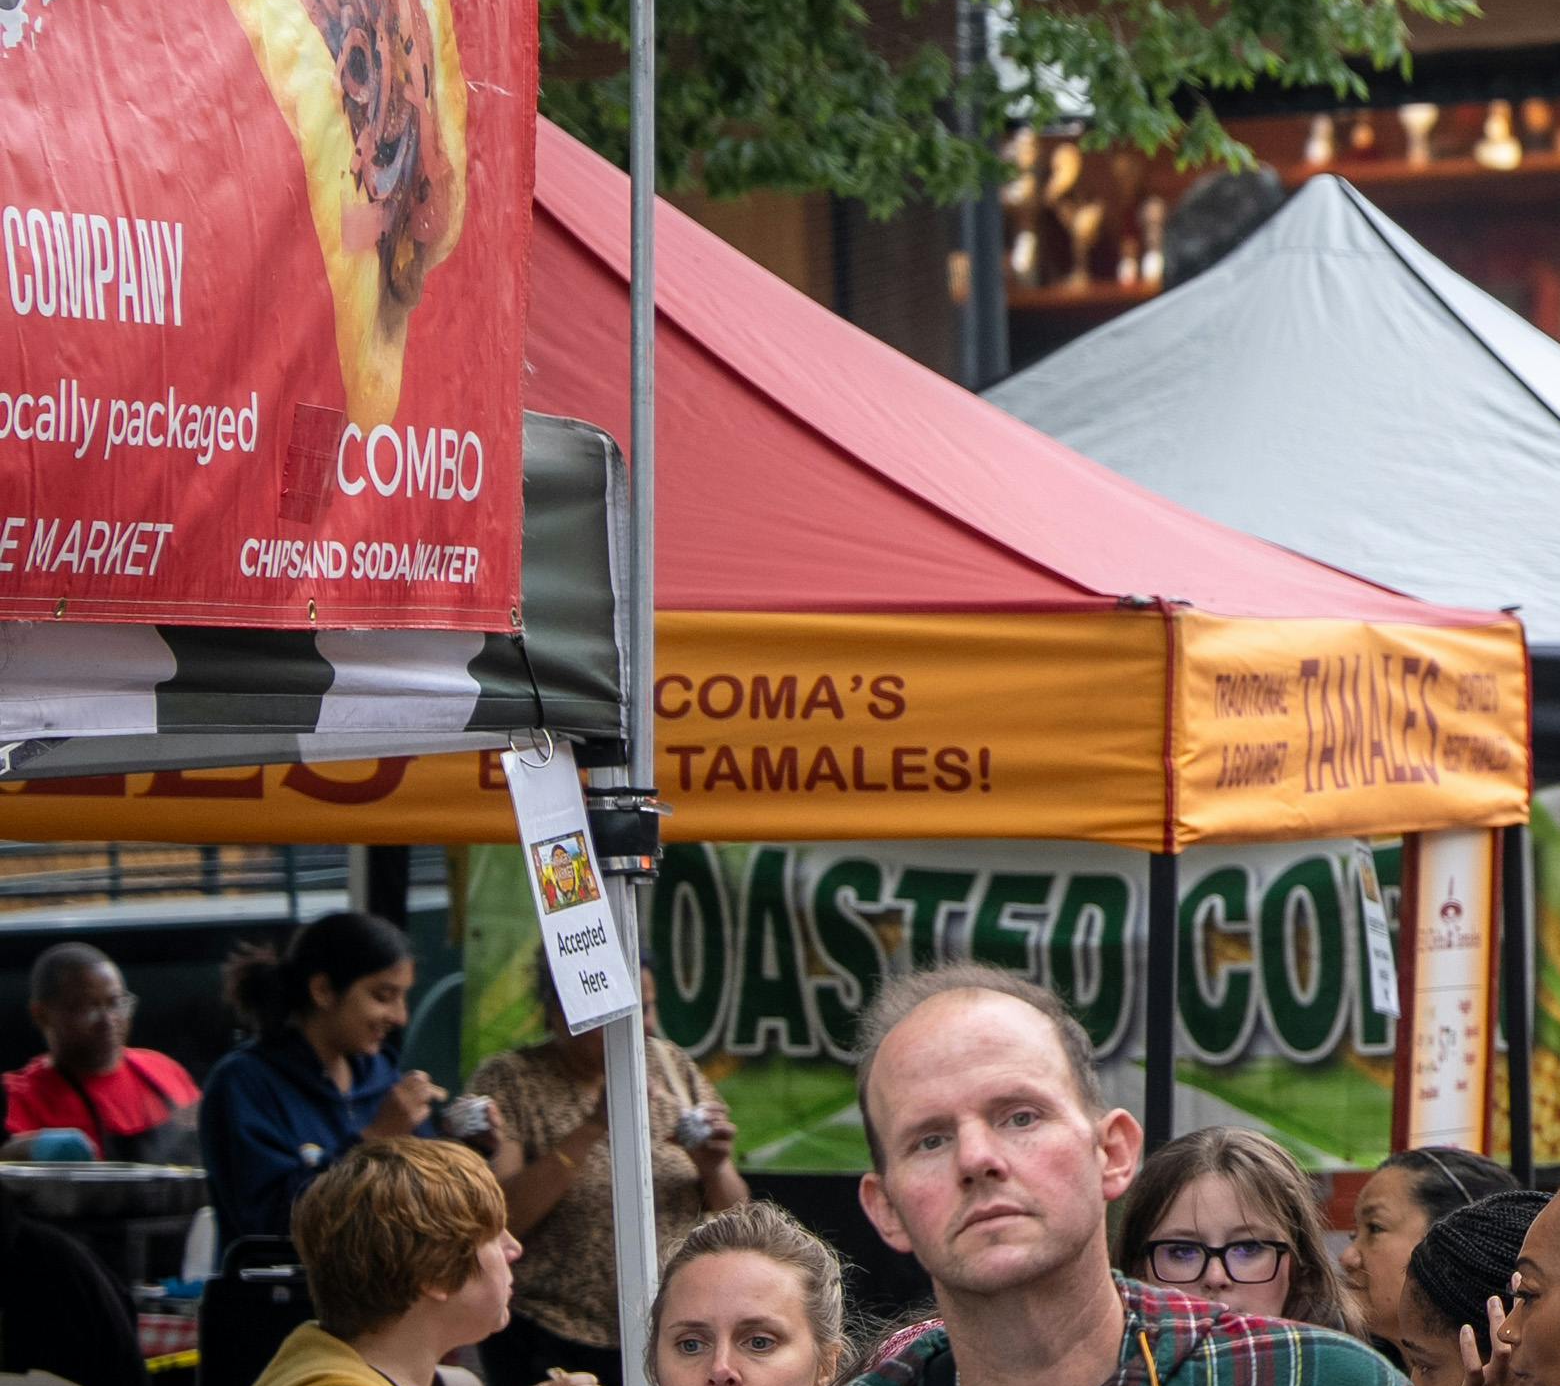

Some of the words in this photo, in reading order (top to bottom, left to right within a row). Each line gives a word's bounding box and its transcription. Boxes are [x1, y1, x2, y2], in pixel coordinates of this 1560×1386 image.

[3, 205, 183, 326] COMPANY
[105, 386, 257, 465] packaged
[336, 422, 483, 502] COMBO
[25, 517, 174, 577] MARKET
[351, 539, 479, 587] SODA/WATER
[1299, 654, 1442, 793] TAMALES
[667, 745, 991, 793] TAMALES!
[557, 918, 606, 957] Accepted
[579, 969, 609, 997] Here
